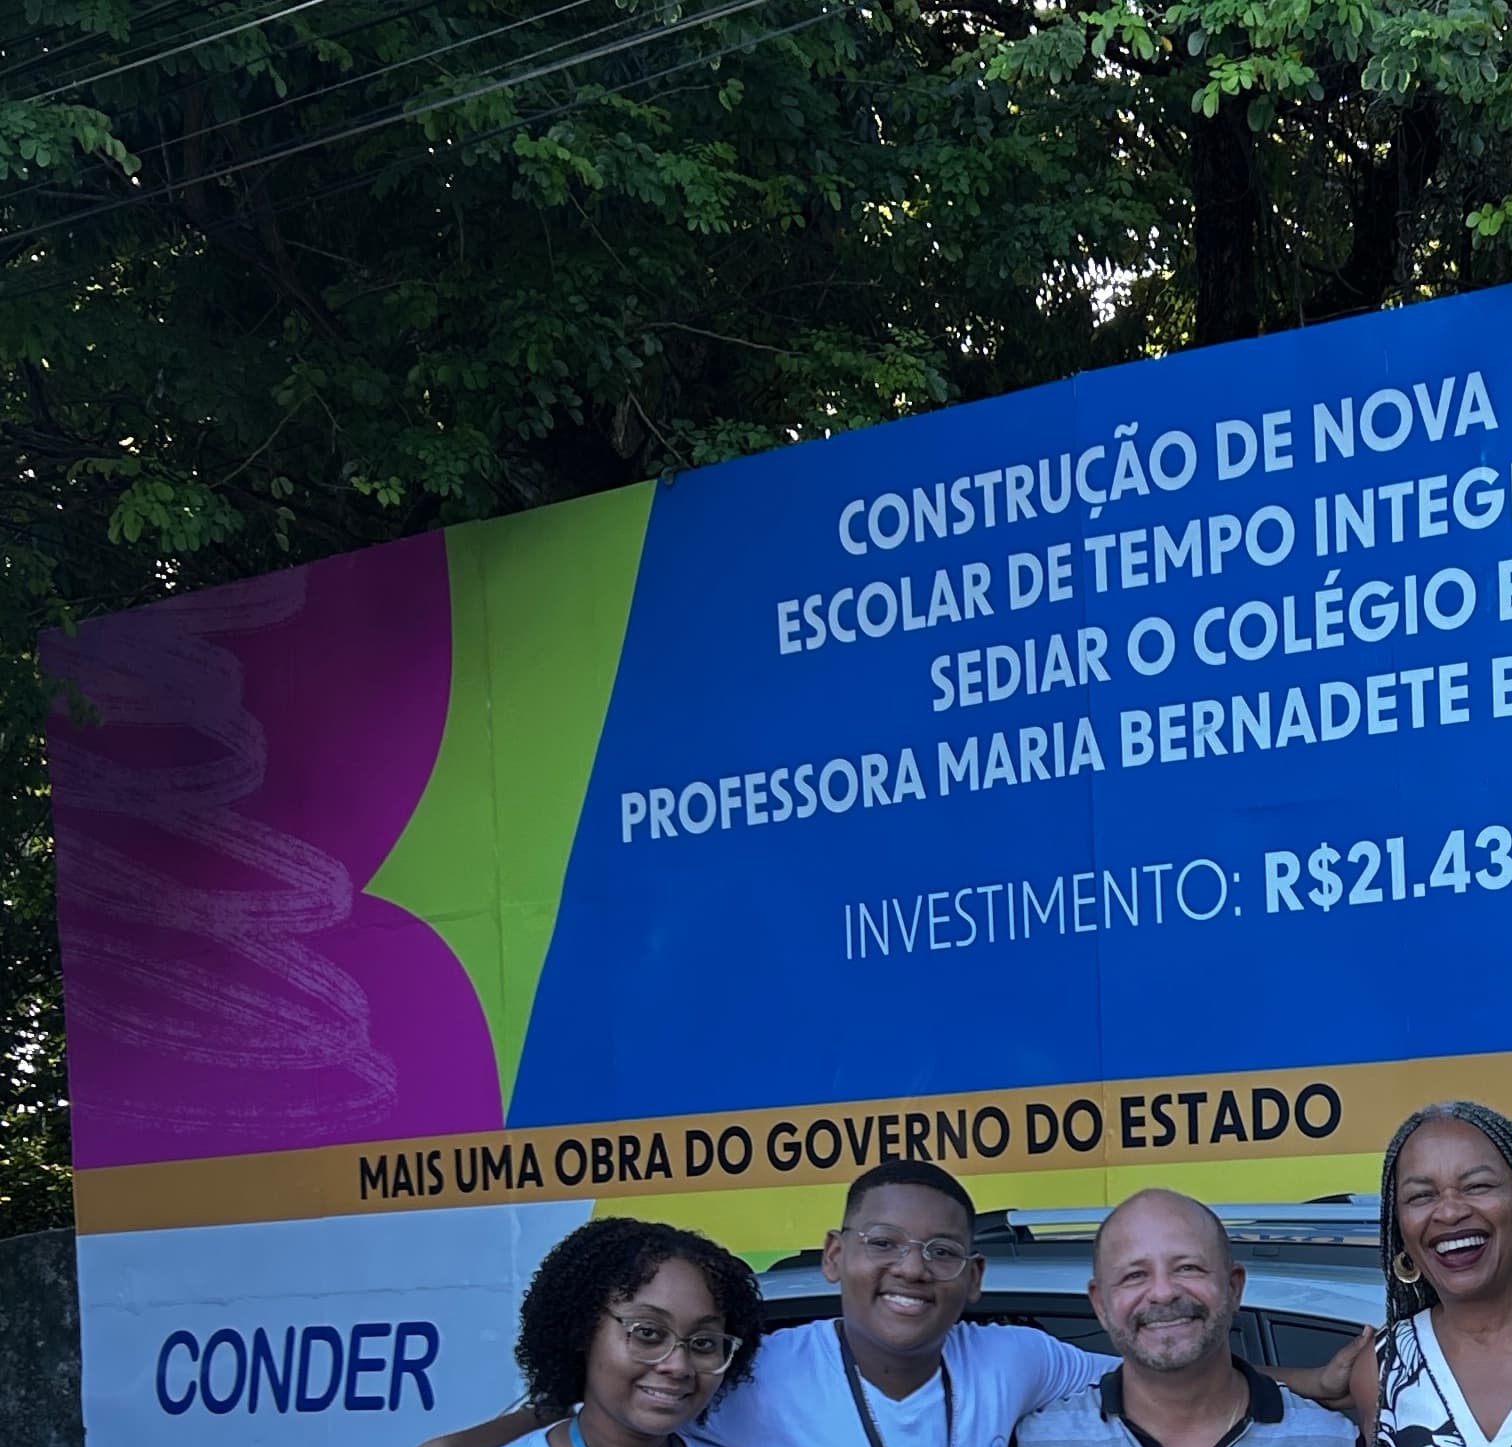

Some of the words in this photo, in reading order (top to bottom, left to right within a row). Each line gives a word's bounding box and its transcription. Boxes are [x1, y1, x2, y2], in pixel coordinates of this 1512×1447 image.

[838, 421, 1197, 555] CONSTRUÇÃO
[1215, 409, 1294, 481] DE
[1313, 371, 1499, 463] NOVA
[777, 562, 995, 655] ESCOLAR
[1008, 542, 1073, 611] DE
[1084, 505, 1295, 593] TEMPO
[930, 626, 1112, 712] SEDIAR
[1127, 616, 1176, 676] O
[1193, 567, 1477, 666] COLÉGIO
[621, 747, 927, 843] PROFESSORA
[937, 717, 1106, 796] MARIA
[1120, 662, 1470, 768] BERNADETE
[845, 858, 1241, 960] INVESTIMENTO:
[358, 1149, 445, 1201] MAIS
[453, 1142, 545, 1194] UMA
[554, 1132, 673, 1187] OBRA
[685, 1125, 753, 1178] DO
[766, 1106, 1011, 1172] GOVERNO
[1025, 1098, 1104, 1155] DO
[1120, 1083, 1342, 1149] ESTADO
[156, 1321, 439, 1416] CONDER
